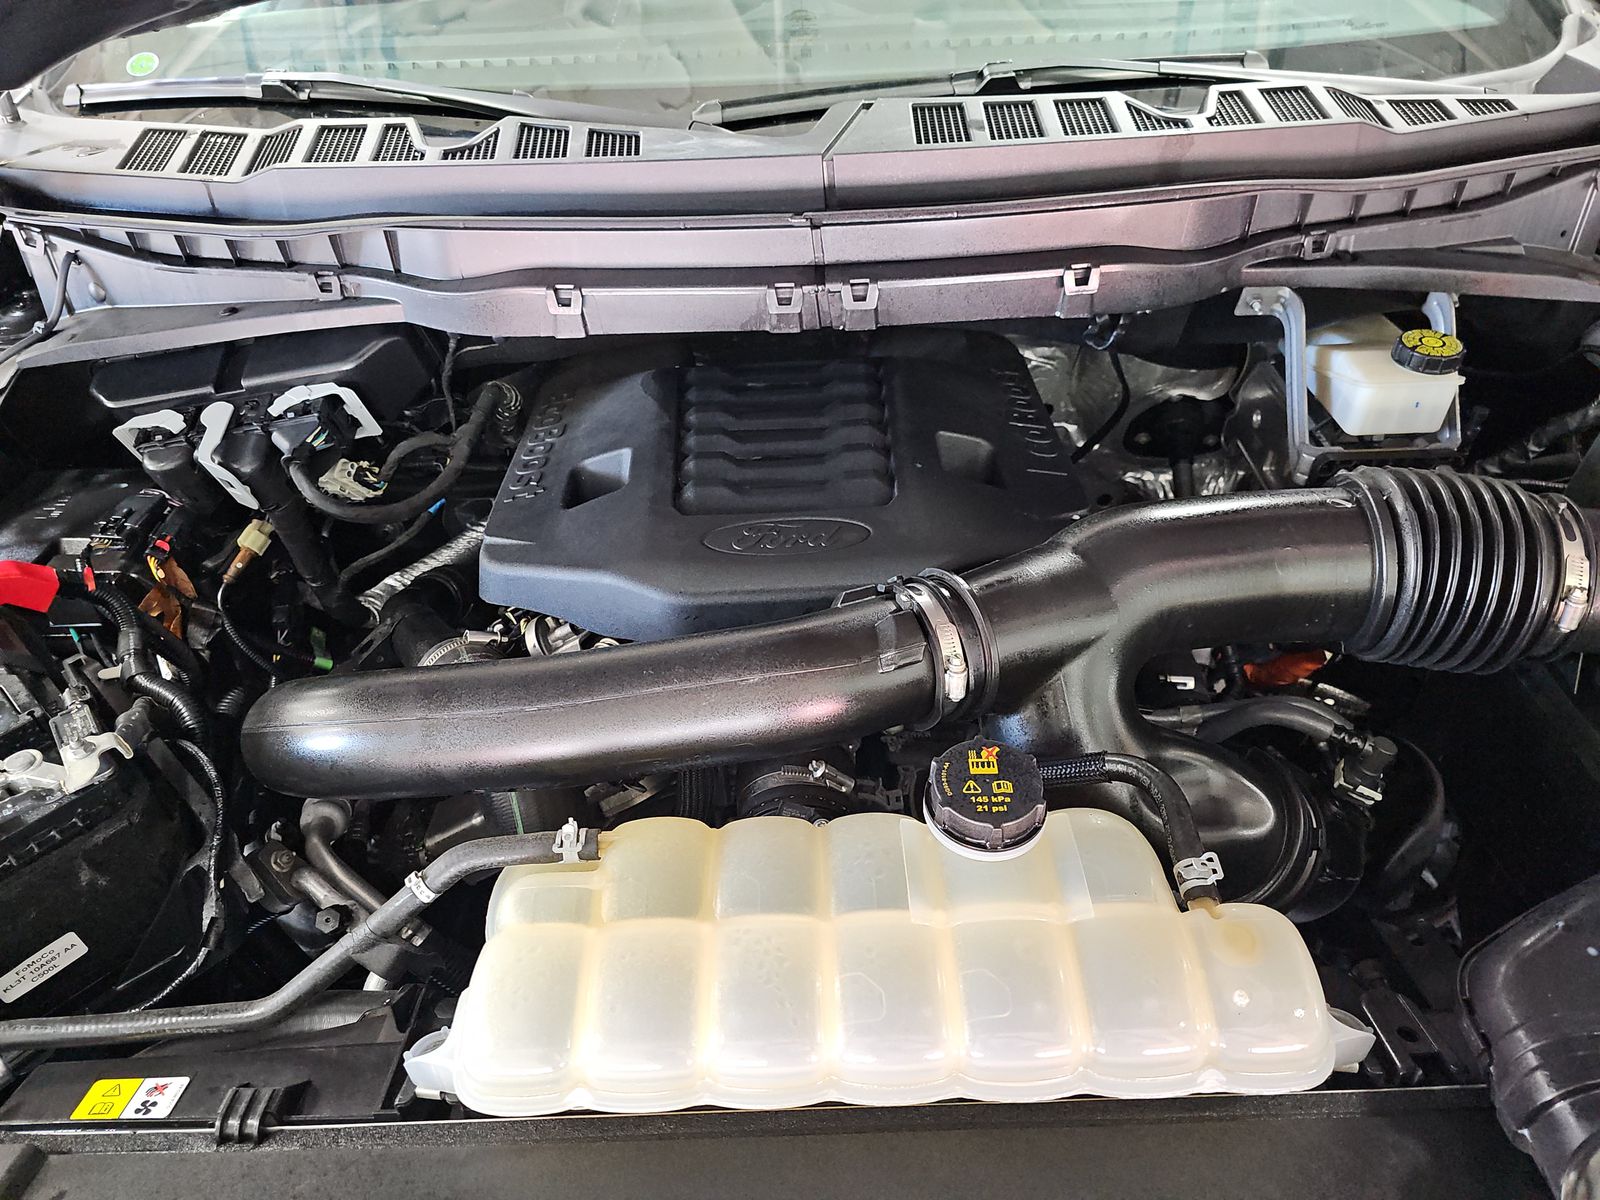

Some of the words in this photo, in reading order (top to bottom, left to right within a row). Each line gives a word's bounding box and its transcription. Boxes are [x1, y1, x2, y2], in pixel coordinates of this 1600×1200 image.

[731, 522, 843, 551] Ford
[2, 975, 26, 994] KL3T
[30, 952, 61, 975] 10A687
[64, 943, 78, 953] AA
[15, 949, 55, 976] FoMoCo
[31, 963, 60, 983] C500L
